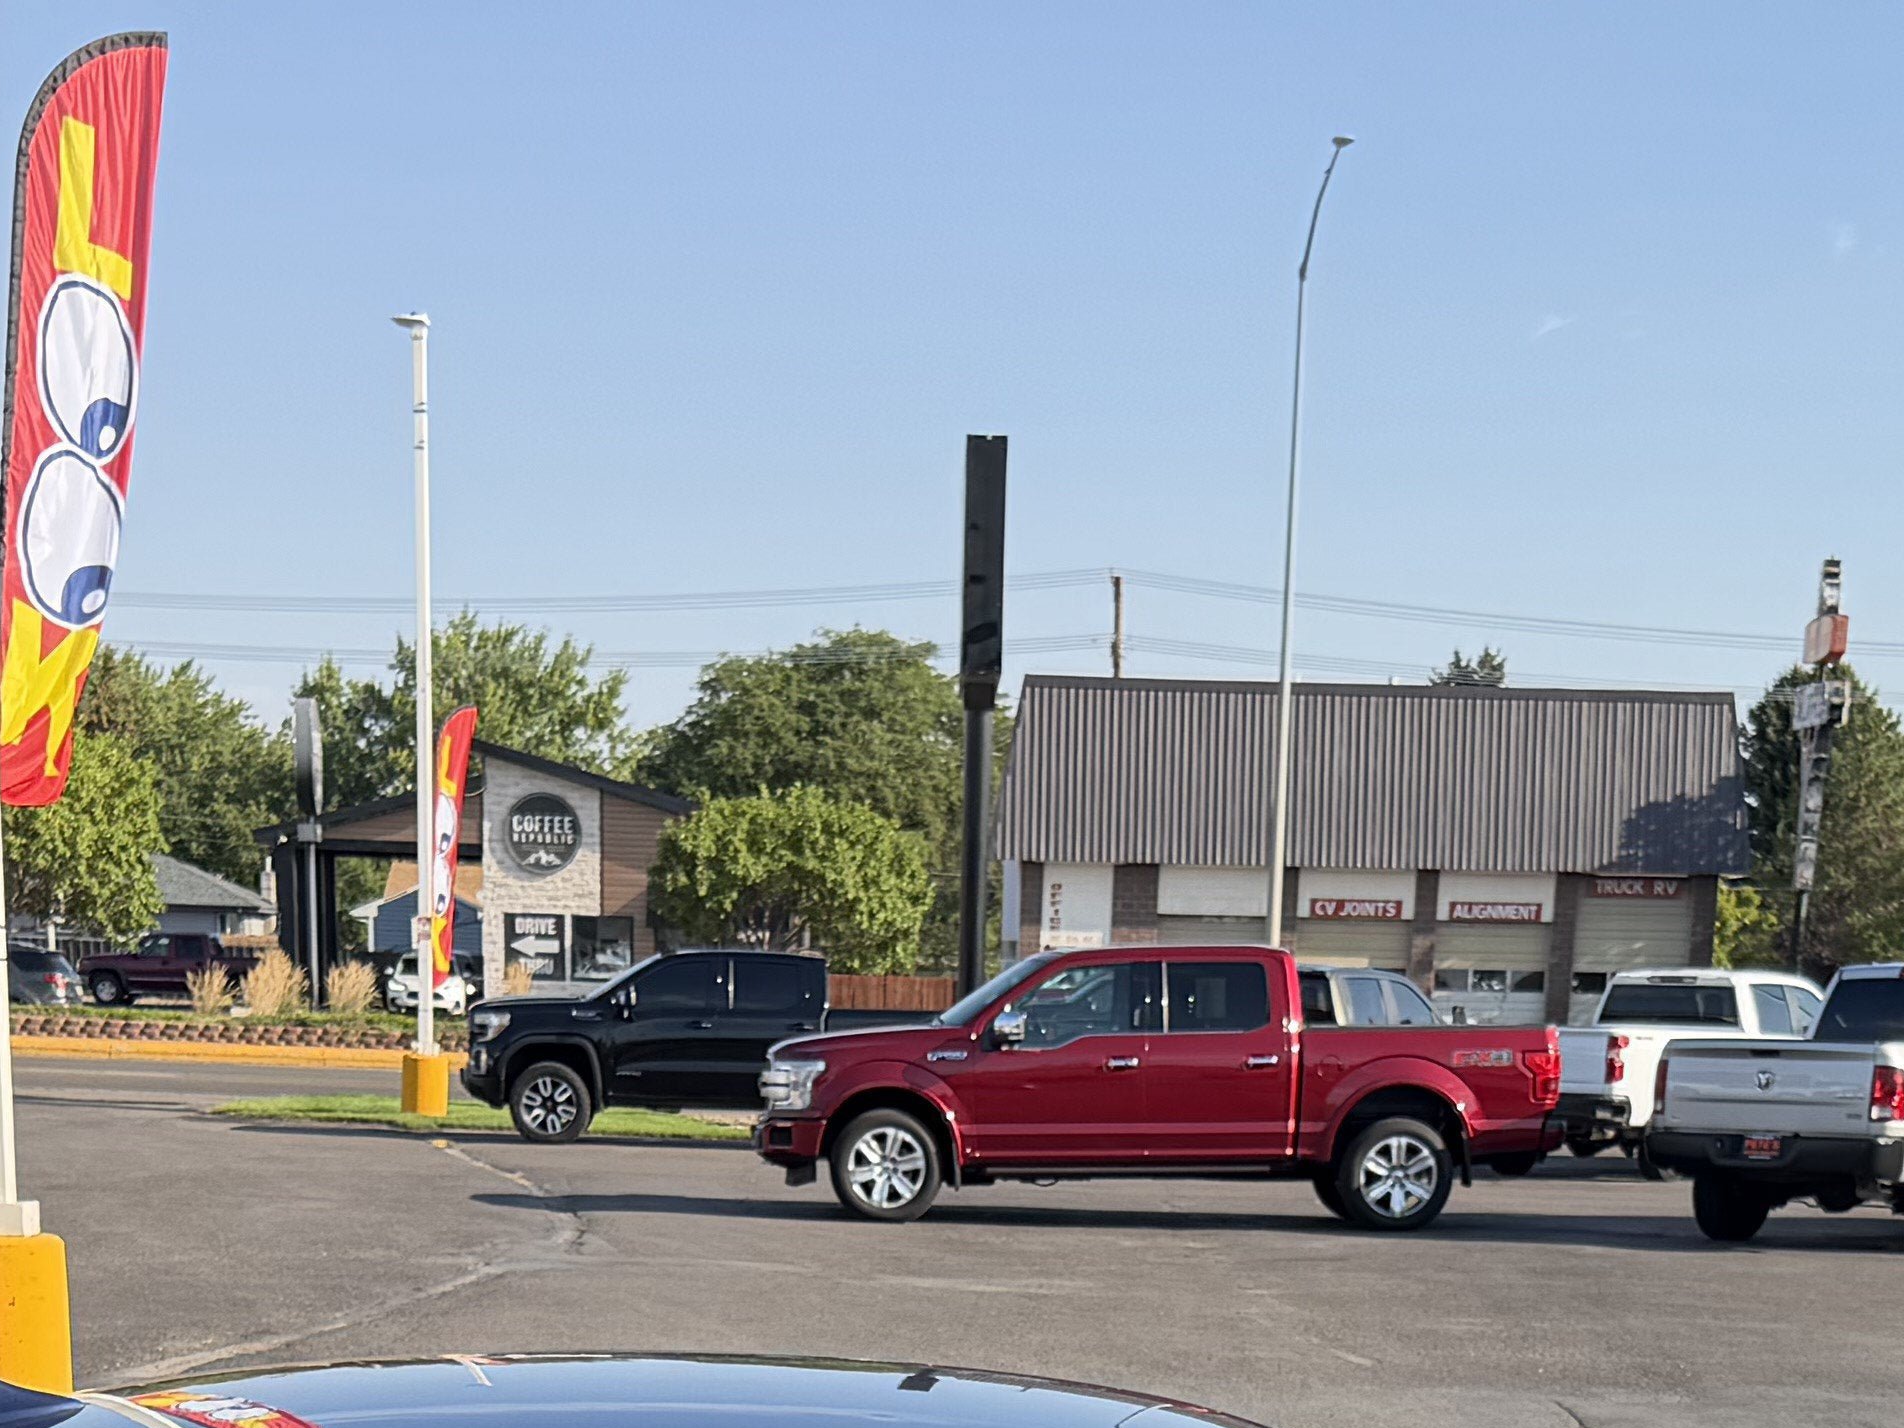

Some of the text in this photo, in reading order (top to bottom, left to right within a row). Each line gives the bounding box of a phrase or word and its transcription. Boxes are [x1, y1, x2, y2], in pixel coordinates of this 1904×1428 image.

[512, 815, 575, 833] COFFEE
[512, 833, 575, 845] REPUBLIC
[1596, 880, 1678, 896] TRUCK RV
[1314, 902, 1397, 917] CV JOINTS
[1452, 904, 1538, 920] ALIGNMENT
[514, 917, 558, 935] DRIVE
